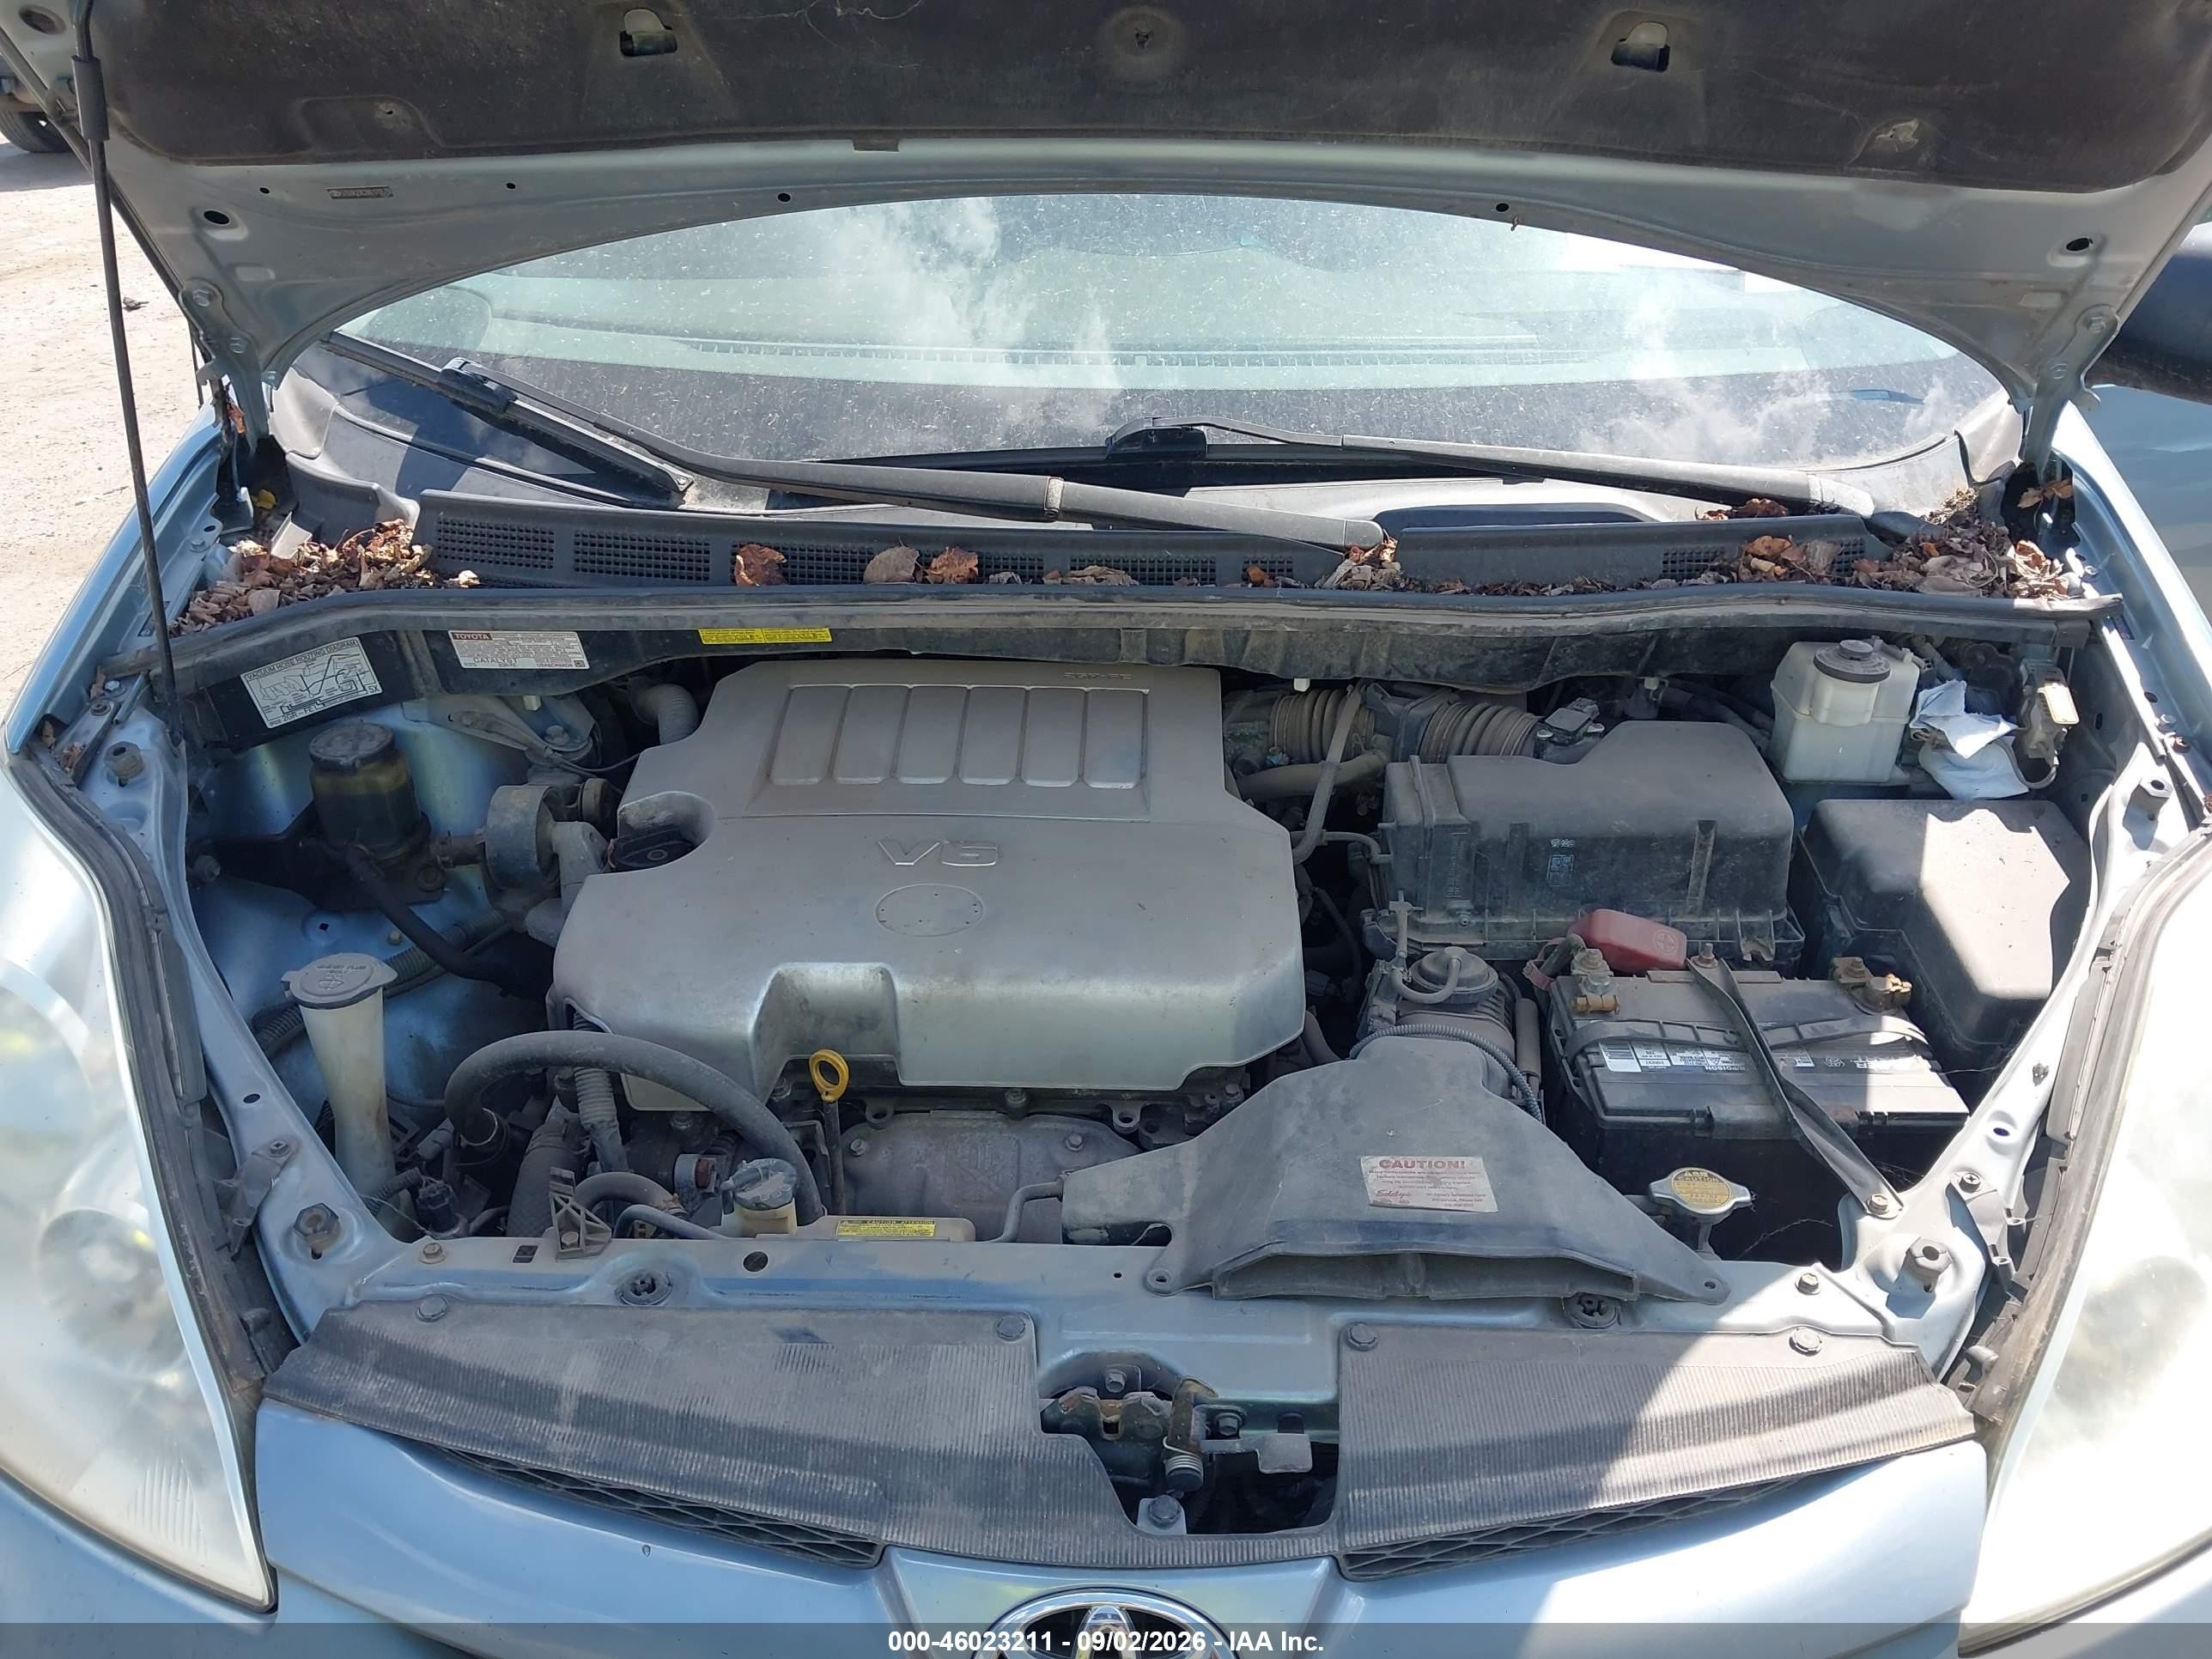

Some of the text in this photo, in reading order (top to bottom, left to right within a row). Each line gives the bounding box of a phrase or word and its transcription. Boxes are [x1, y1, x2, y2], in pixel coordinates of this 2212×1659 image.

[247, 640, 356, 681] VACUUM HOSE ROUTING DIAGRAM
[877, 841, 1000, 866] V6
[1379, 1159, 1466, 1169] CAUTION!
